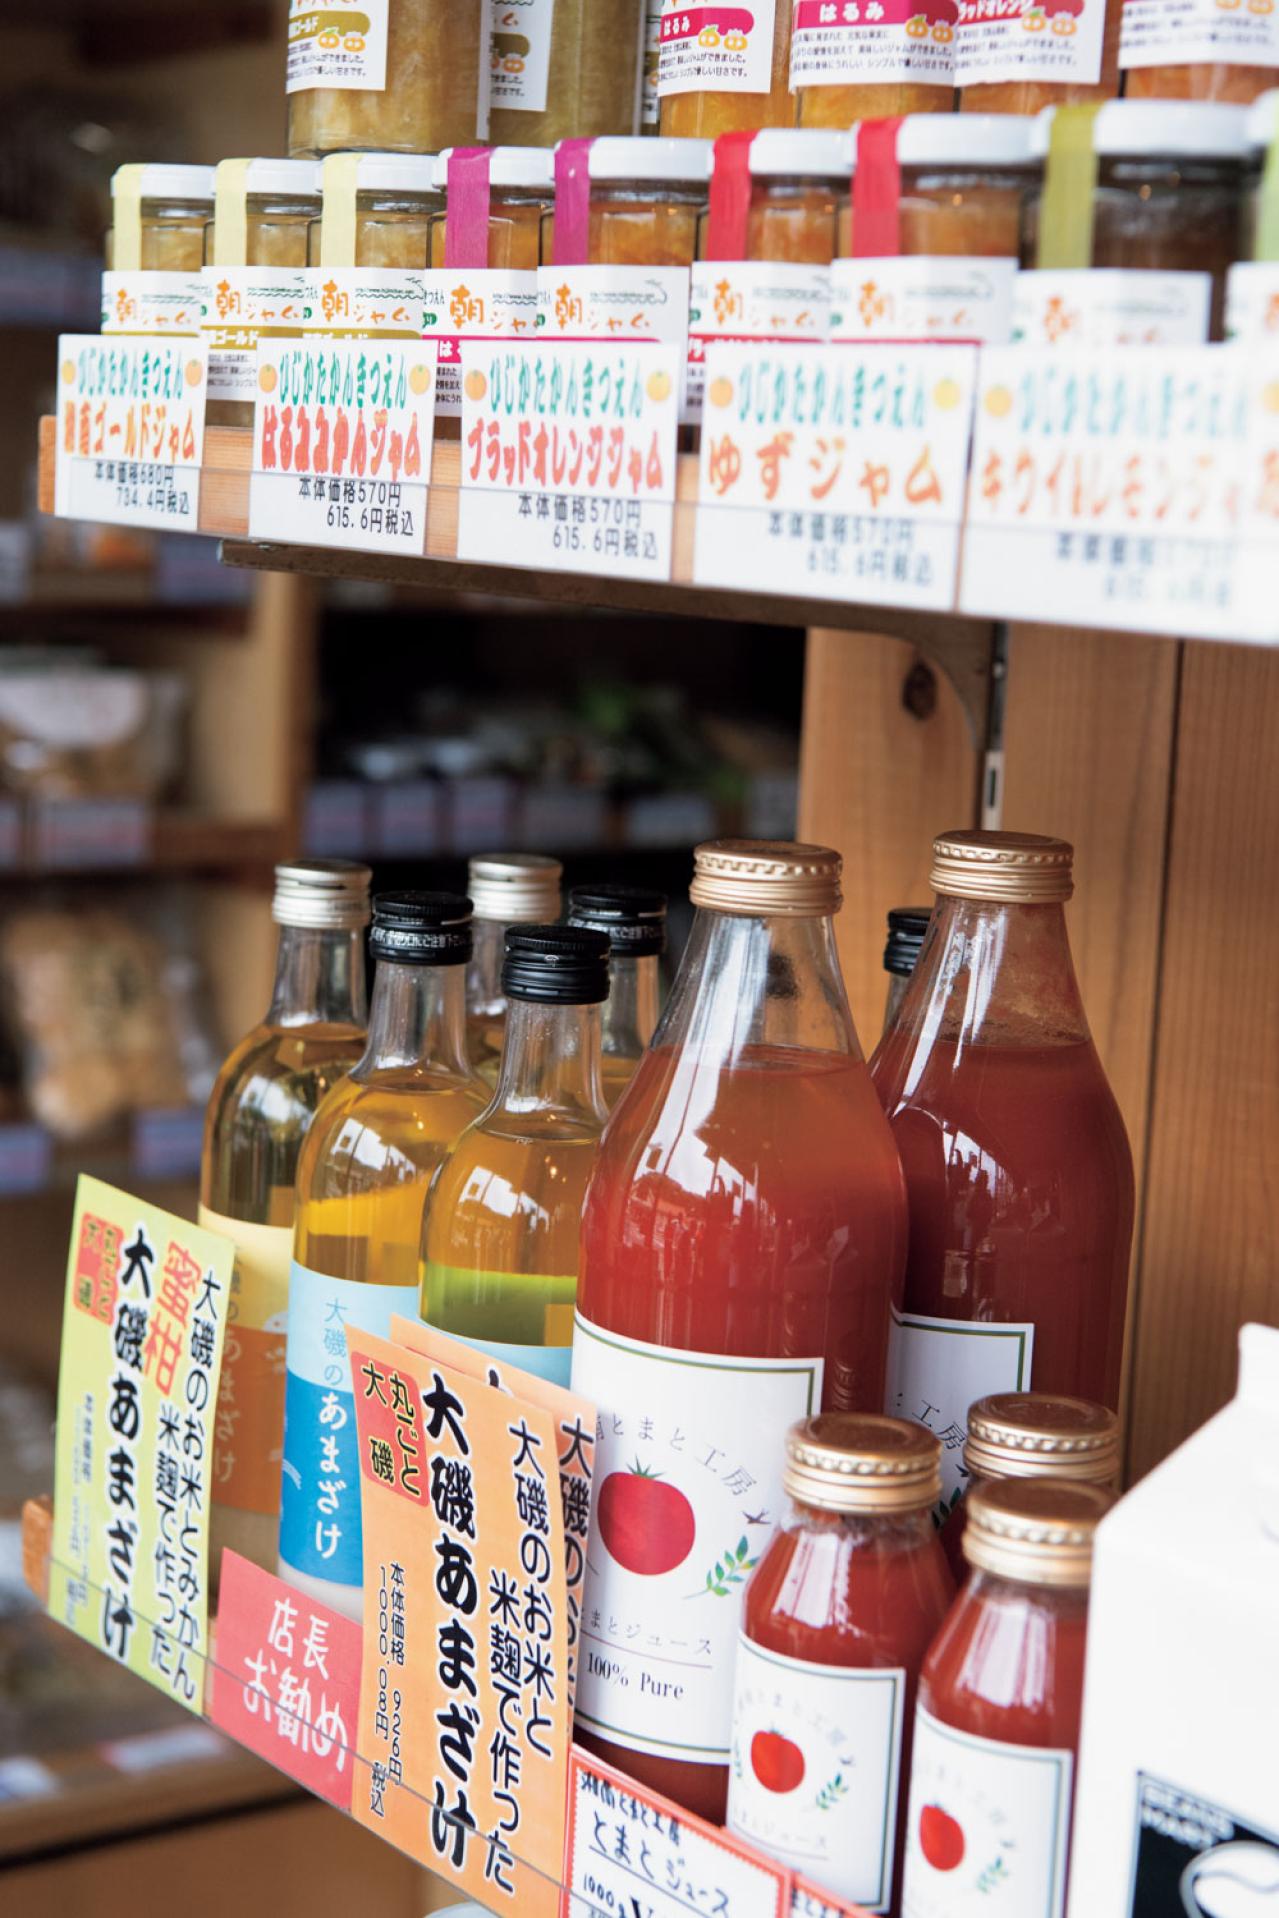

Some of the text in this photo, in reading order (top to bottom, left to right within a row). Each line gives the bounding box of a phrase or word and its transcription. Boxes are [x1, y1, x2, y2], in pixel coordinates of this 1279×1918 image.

[663, 15, 690, 36] はるみ
[819, 1, 884, 23] はるみ
[280, 351, 407, 409] ひじかたかんきつえん
[490, 353, 644, 418] ひじかたかんきつえん
[299, 477, 401, 508] 本体価格570円
[468, 416, 663, 495] ブラッドオレンジジャム
[709, 431, 942, 509] ゆずジャム
[327, 505, 414, 537] 615.6円税込
[518, 493, 642, 528] 本体価格570円
[553, 525, 658, 560] 615.6円税込
[142, 1240, 202, 1396] 蜜柑
[104, 1228, 154, 1659] 大磯あまざけ
[361, 1362, 395, 1485] 大磯
[389, 1372, 421, 1495] 丸ごと
[423, 1373, 480, 1868] 大磯あまざけ
[509, 1420, 556, 1757] 大磯のお米と
[267, 1597, 330, 1681] 店長
[388, 1562, 406, 1786] 本体価格 926円
[587, 1652, 684, 1700] 100% Pure
[243, 1647, 348, 1773] お勧め
[485, 1568, 523, 1893] 米麹で作った
